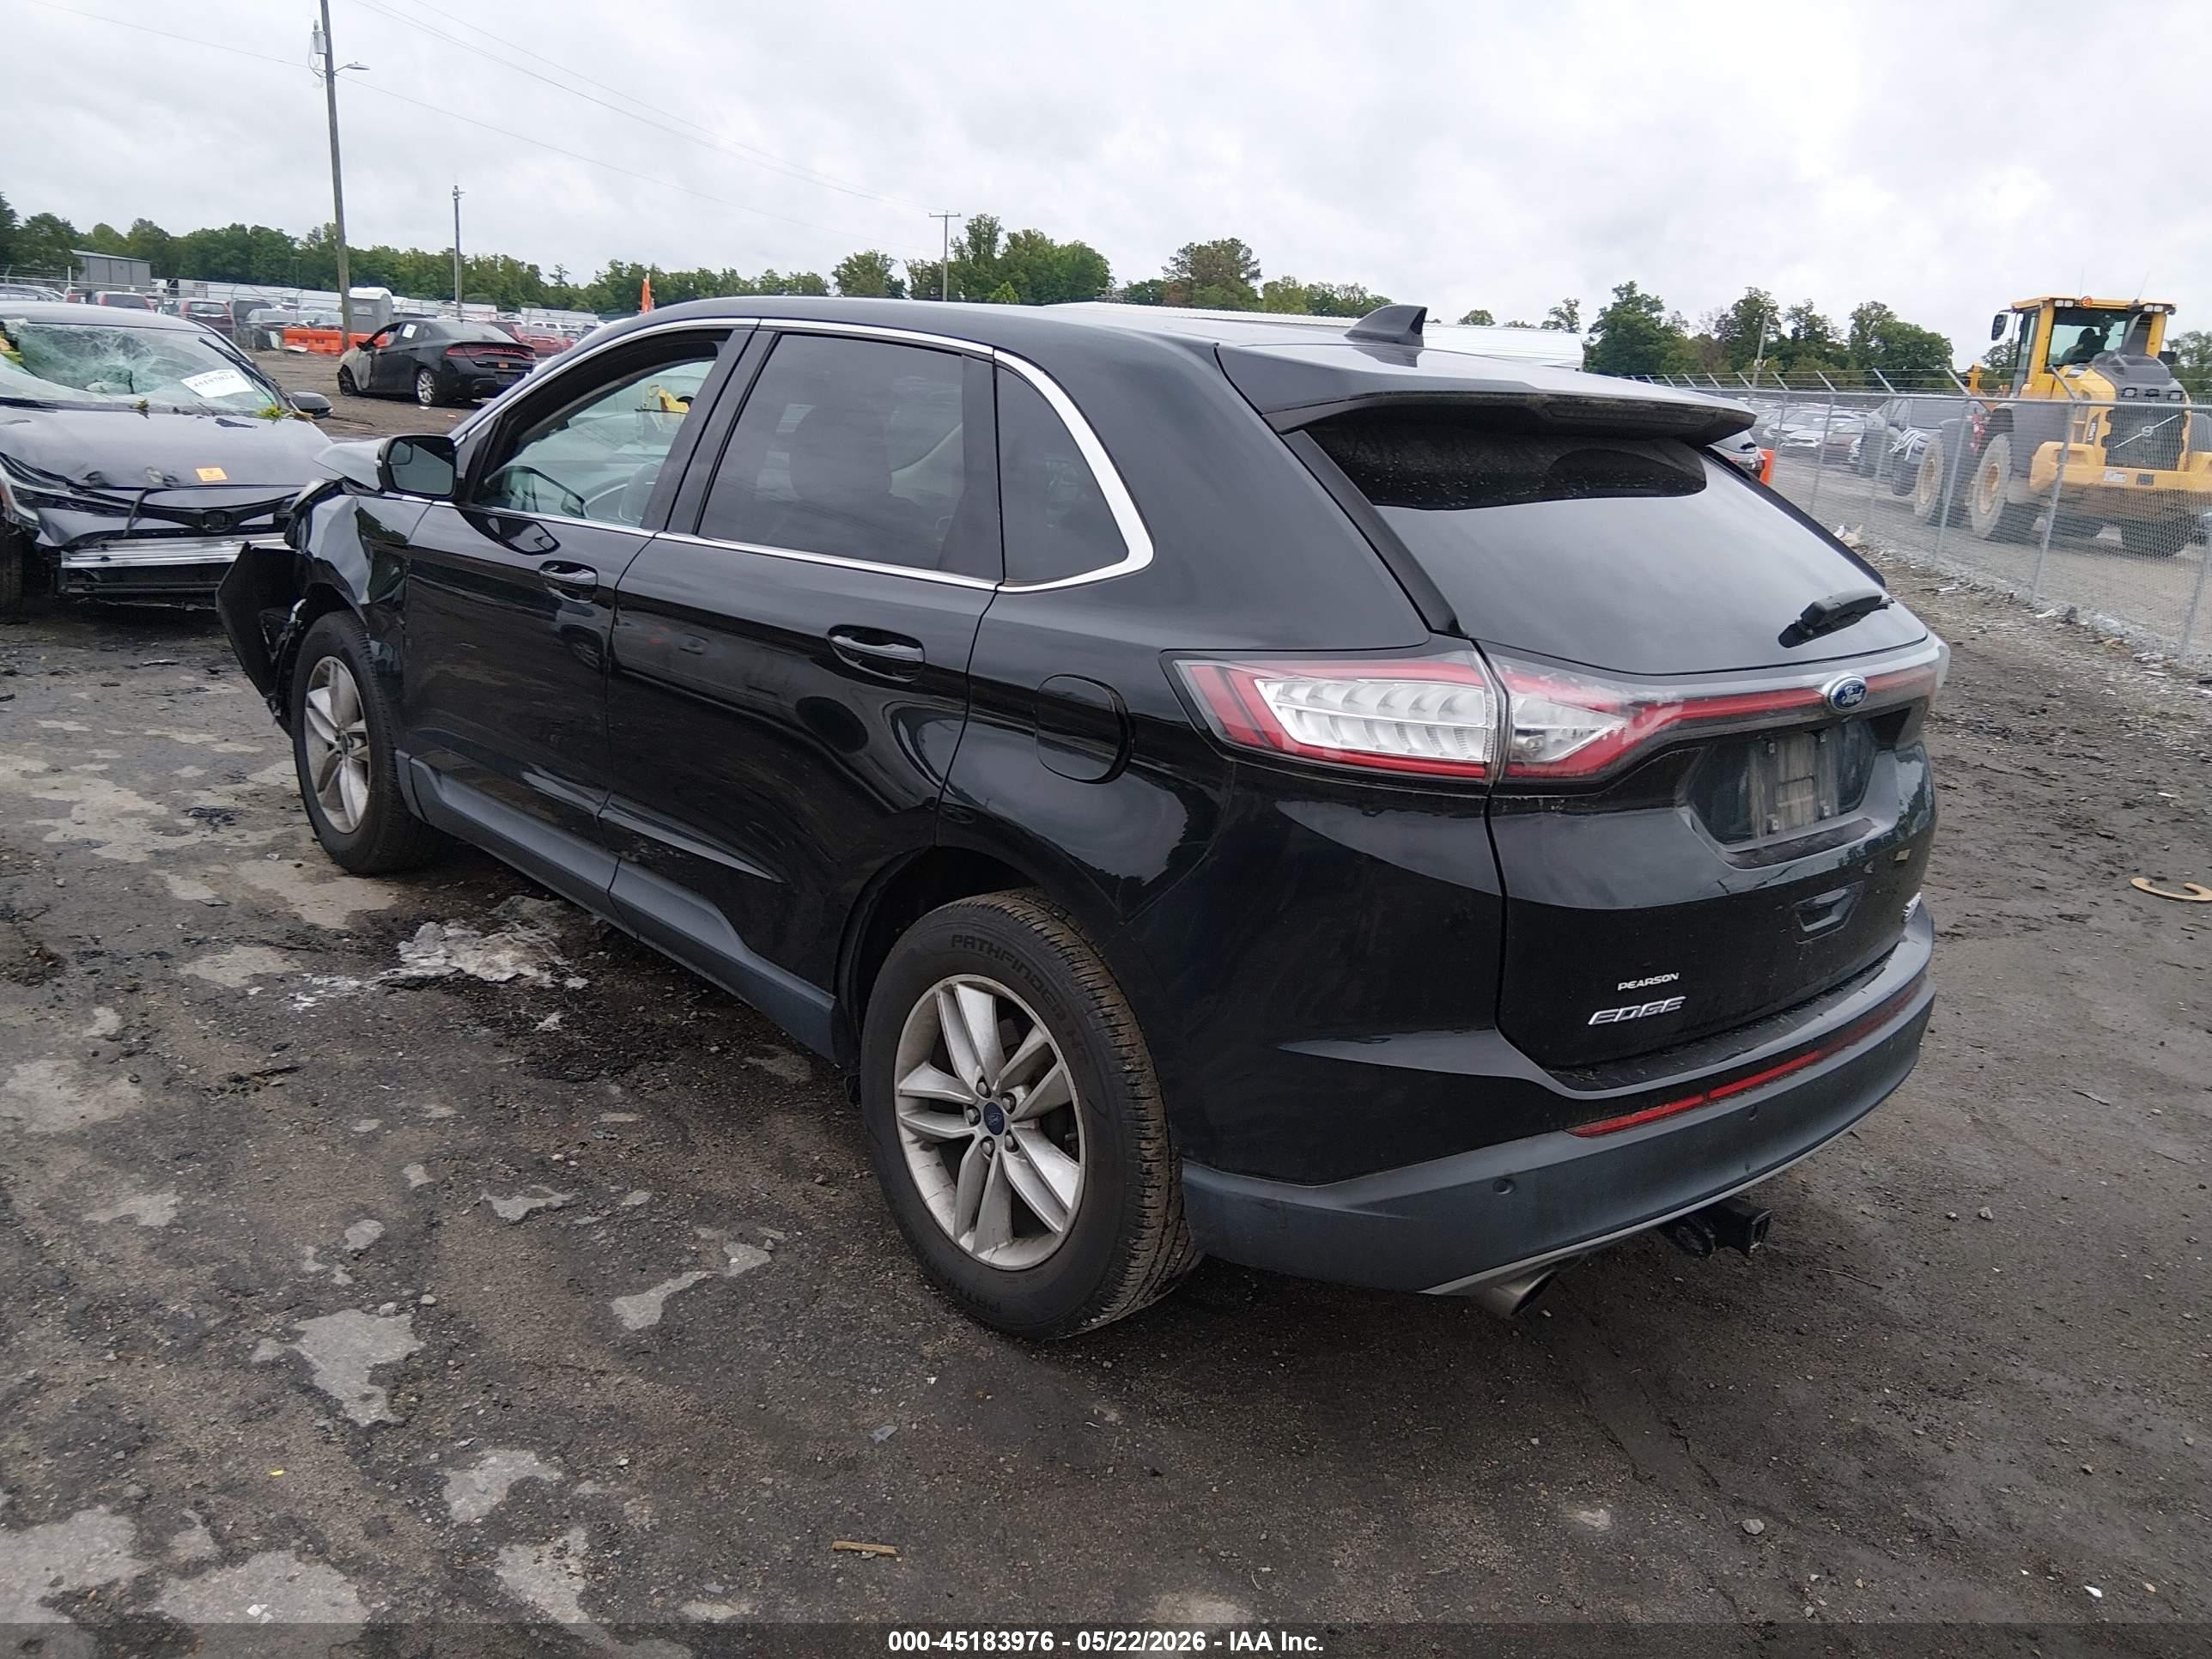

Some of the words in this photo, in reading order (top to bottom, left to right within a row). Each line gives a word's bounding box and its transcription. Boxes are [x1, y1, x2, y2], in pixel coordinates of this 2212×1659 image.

[950, 933, 1067, 1021] PATHFINDER
[1617, 972, 1680, 991] PEARSON
[1587, 995, 1686, 1025] EDGE
